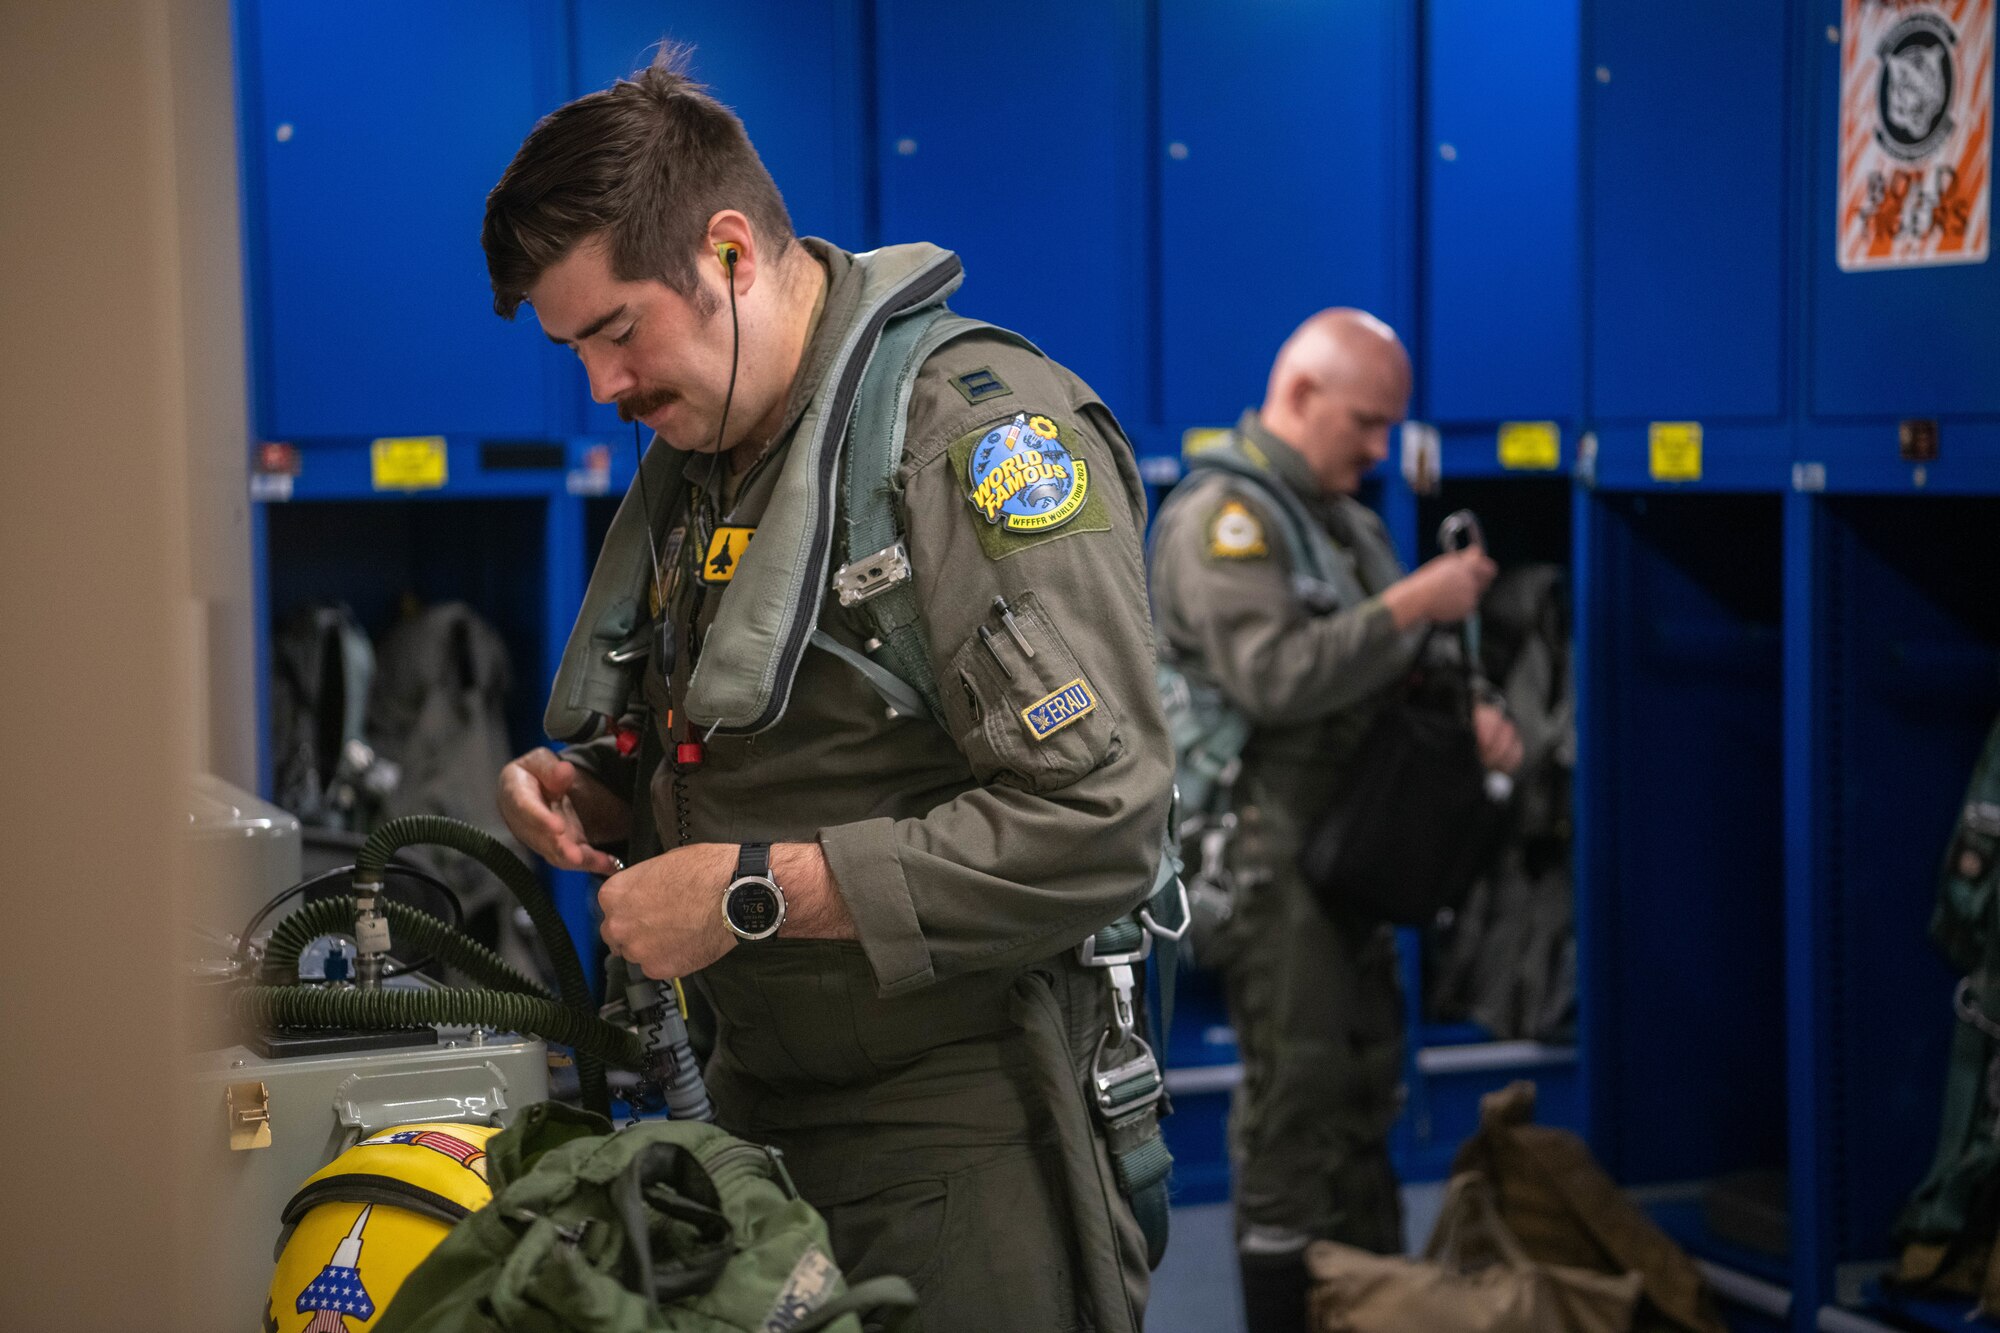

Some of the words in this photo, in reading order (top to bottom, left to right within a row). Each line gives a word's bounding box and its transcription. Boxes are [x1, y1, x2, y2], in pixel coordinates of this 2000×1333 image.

[973, 450, 1043, 508] WORLD
[985, 464, 1068, 518] FAMOUS
[1012, 516, 1048, 526] WFFFFR
[1049, 501, 1074, 521] WORLD
[1072, 483, 1084, 502] TOUR
[1046, 686, 1088, 723] ERAU
